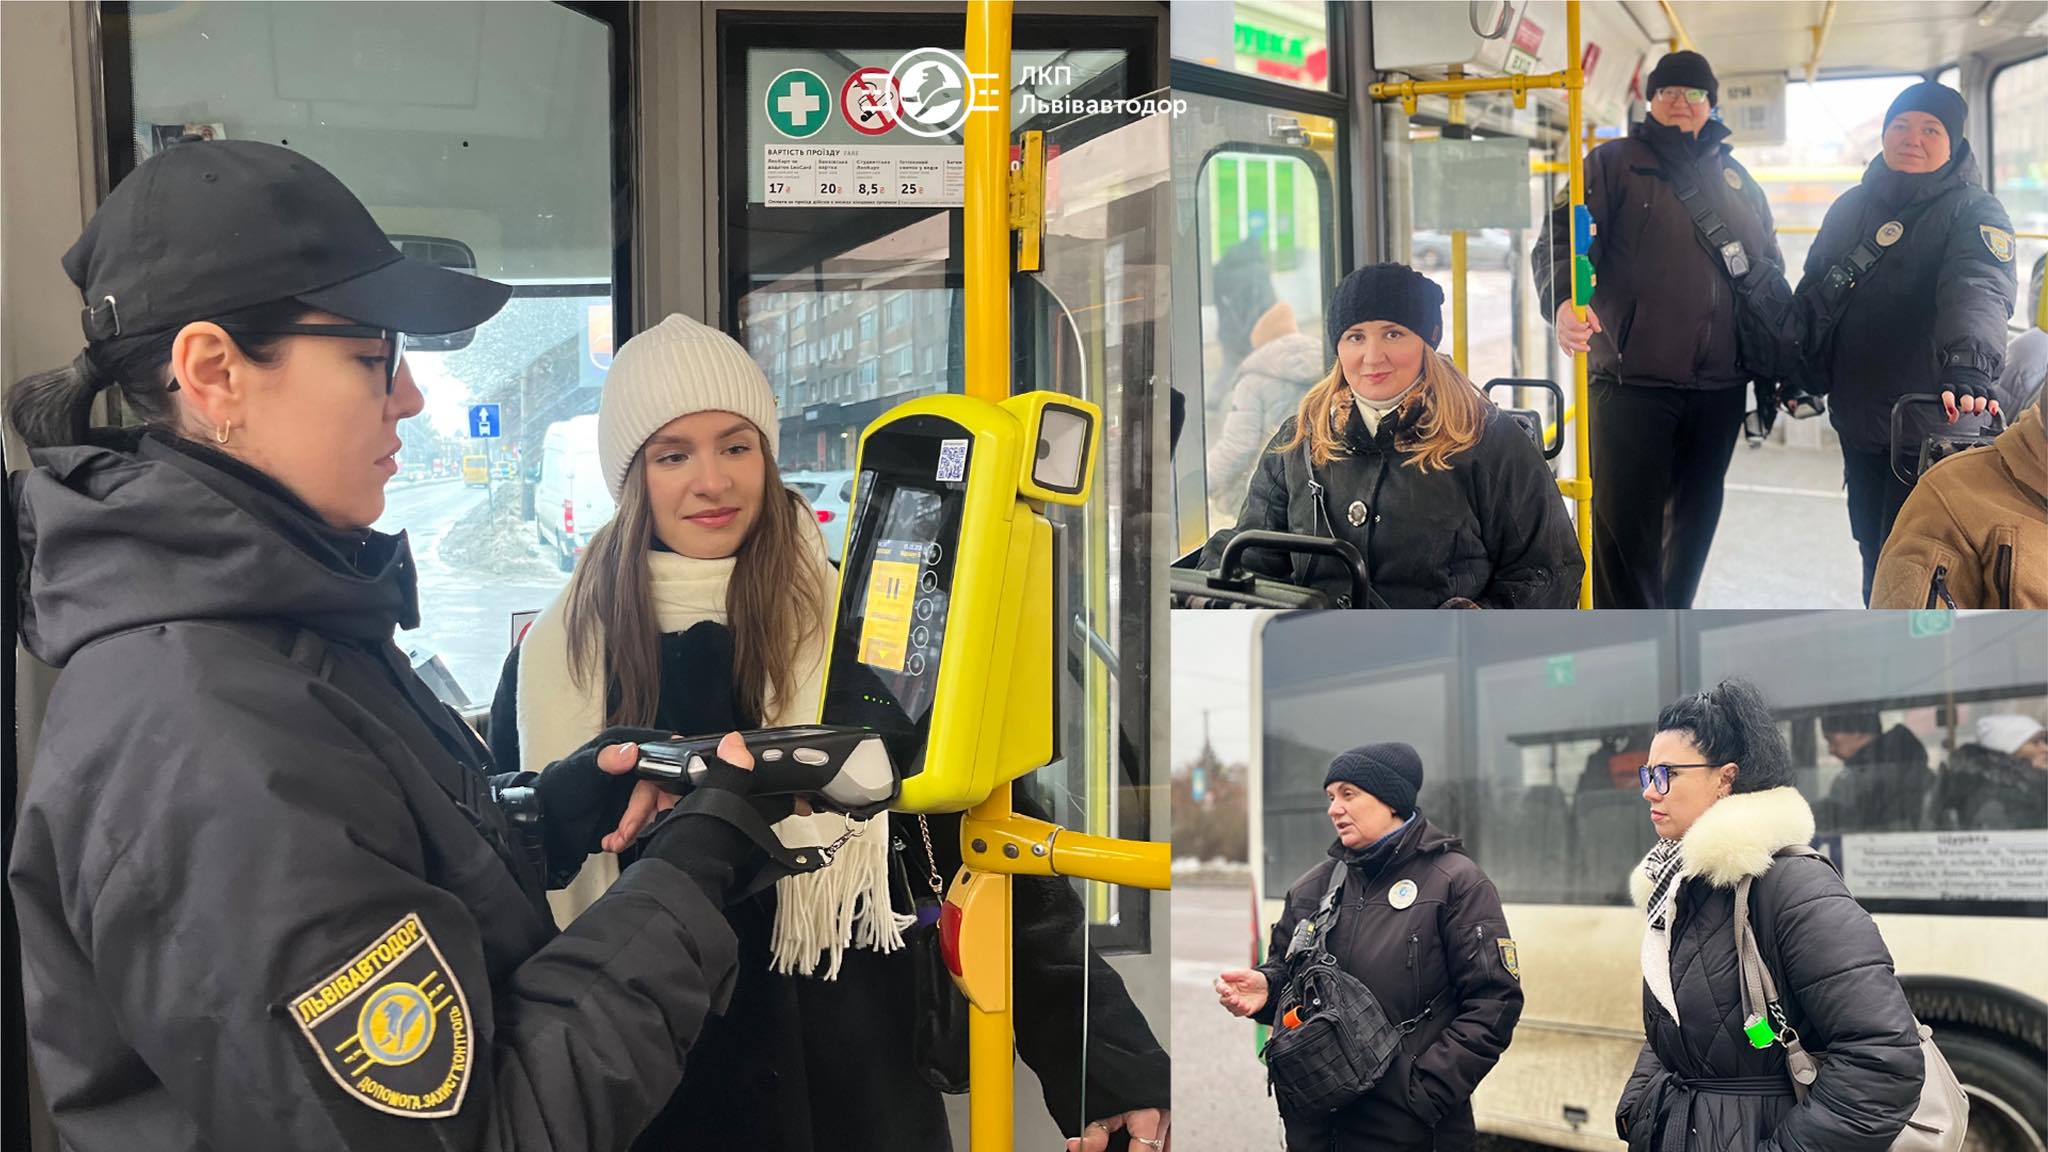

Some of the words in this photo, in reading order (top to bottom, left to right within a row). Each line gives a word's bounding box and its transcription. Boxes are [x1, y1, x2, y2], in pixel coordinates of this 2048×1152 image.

[806, 148, 840, 156] ПРОЇЗДУ
[769, 183, 784, 194] 17
[820, 183, 836, 194] 20
[858, 183, 878, 196] 8,5
[901, 183, 917, 194] 25
[298, 920, 419, 1022] ЛЬВІВАВТОДОР
